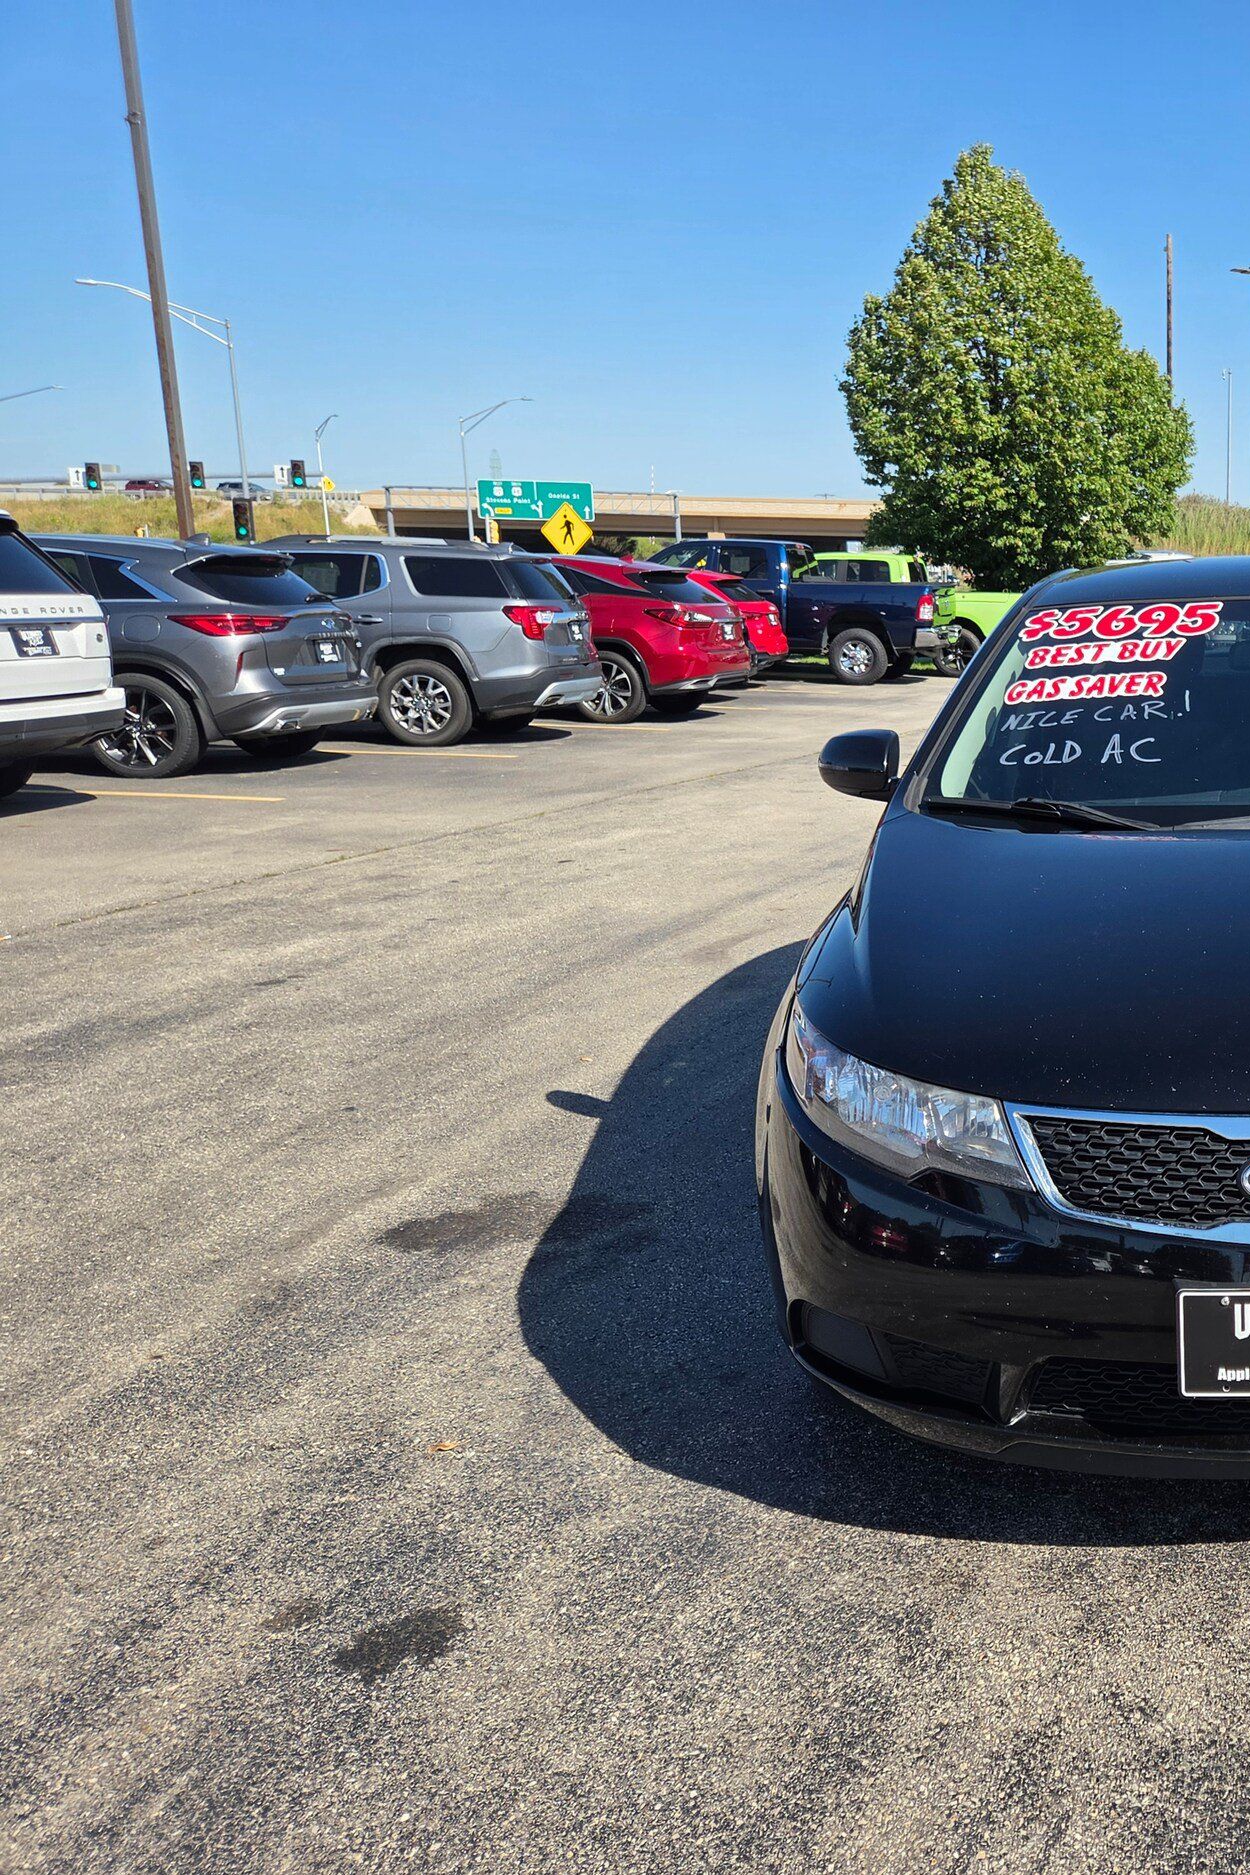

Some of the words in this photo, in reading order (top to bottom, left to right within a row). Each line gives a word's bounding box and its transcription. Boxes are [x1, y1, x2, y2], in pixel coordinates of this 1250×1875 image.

[40, 606, 84, 614] ROVER
[1019, 602, 1223, 642] $5695
[1024, 643, 1113, 669] BEST
[1114, 638, 1187, 663] BUY
[1004, 676, 1068, 705] GAS
[1067, 671, 1168, 699] SAVER
[1001, 708, 1084, 731] NICE
[1100, 733, 1162, 764] AC
